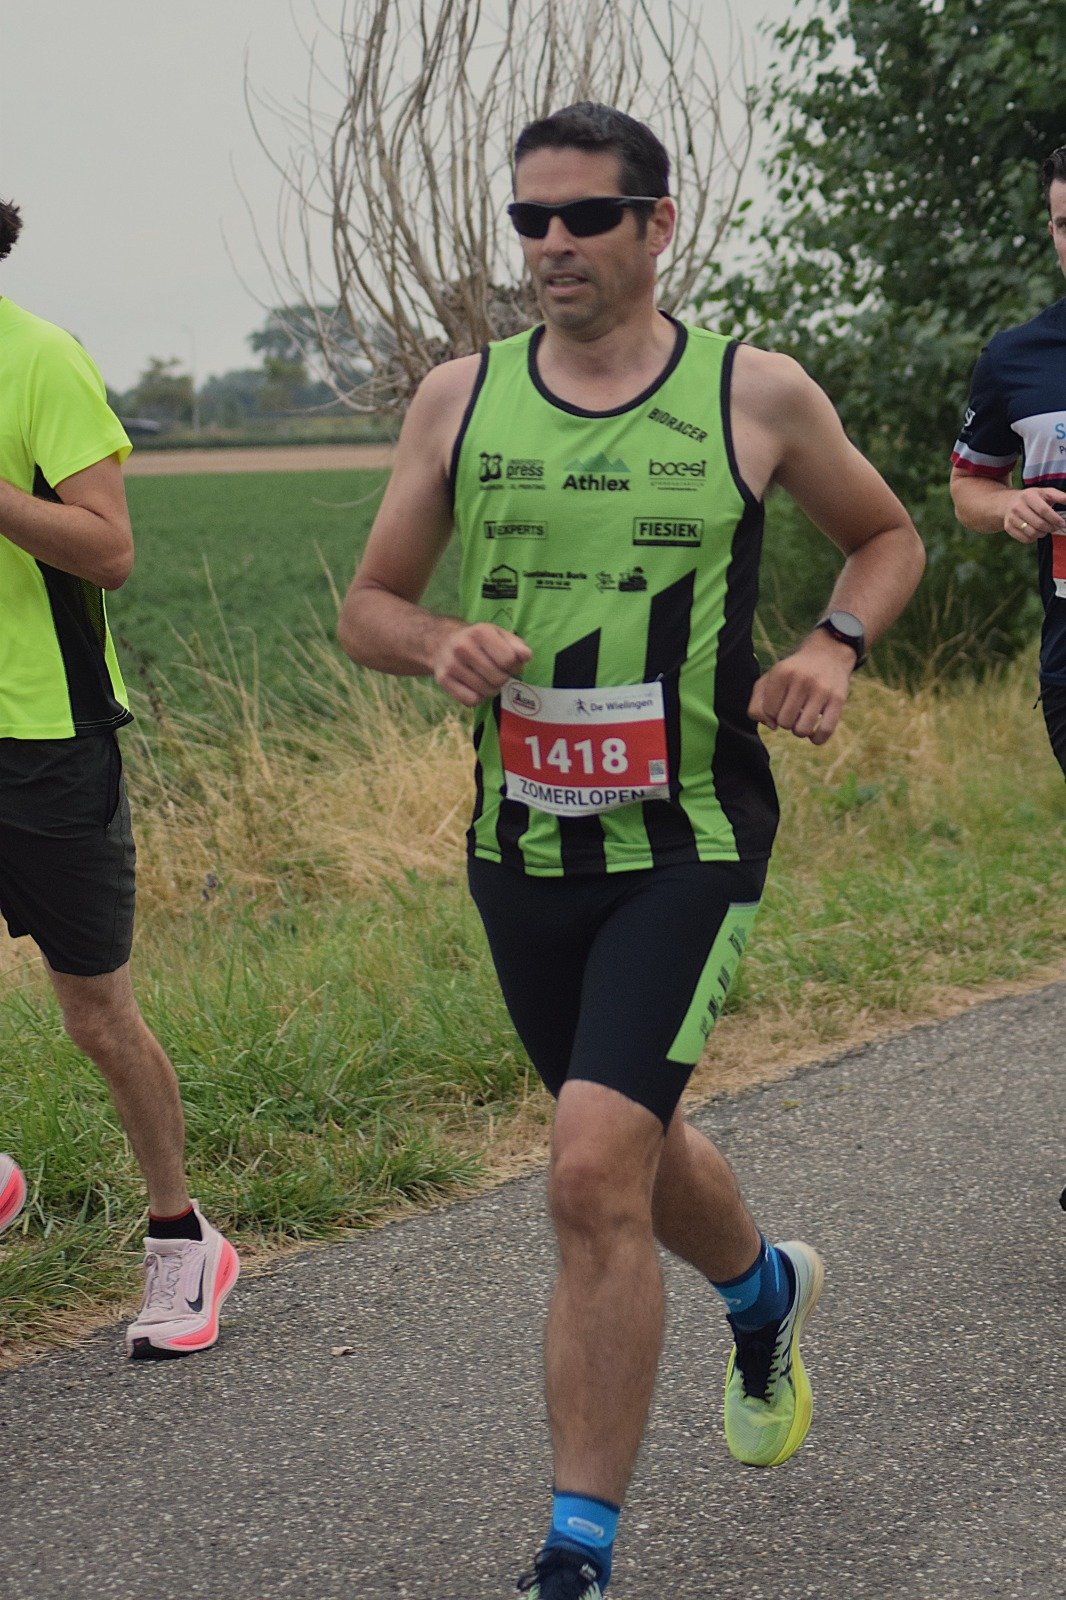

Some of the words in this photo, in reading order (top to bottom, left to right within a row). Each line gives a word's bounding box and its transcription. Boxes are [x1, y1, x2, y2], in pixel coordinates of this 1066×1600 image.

[648, 407, 708, 443] BIORACER
[562, 475, 630, 491] Athlex
[640, 523, 697, 537] FIESIEK
[591, 703, 603, 711] De
[606, 699, 653, 711] Wielingen
[524, 735, 629, 774] 1418
[519, 778, 645, 805] ZOMERLOPEN
